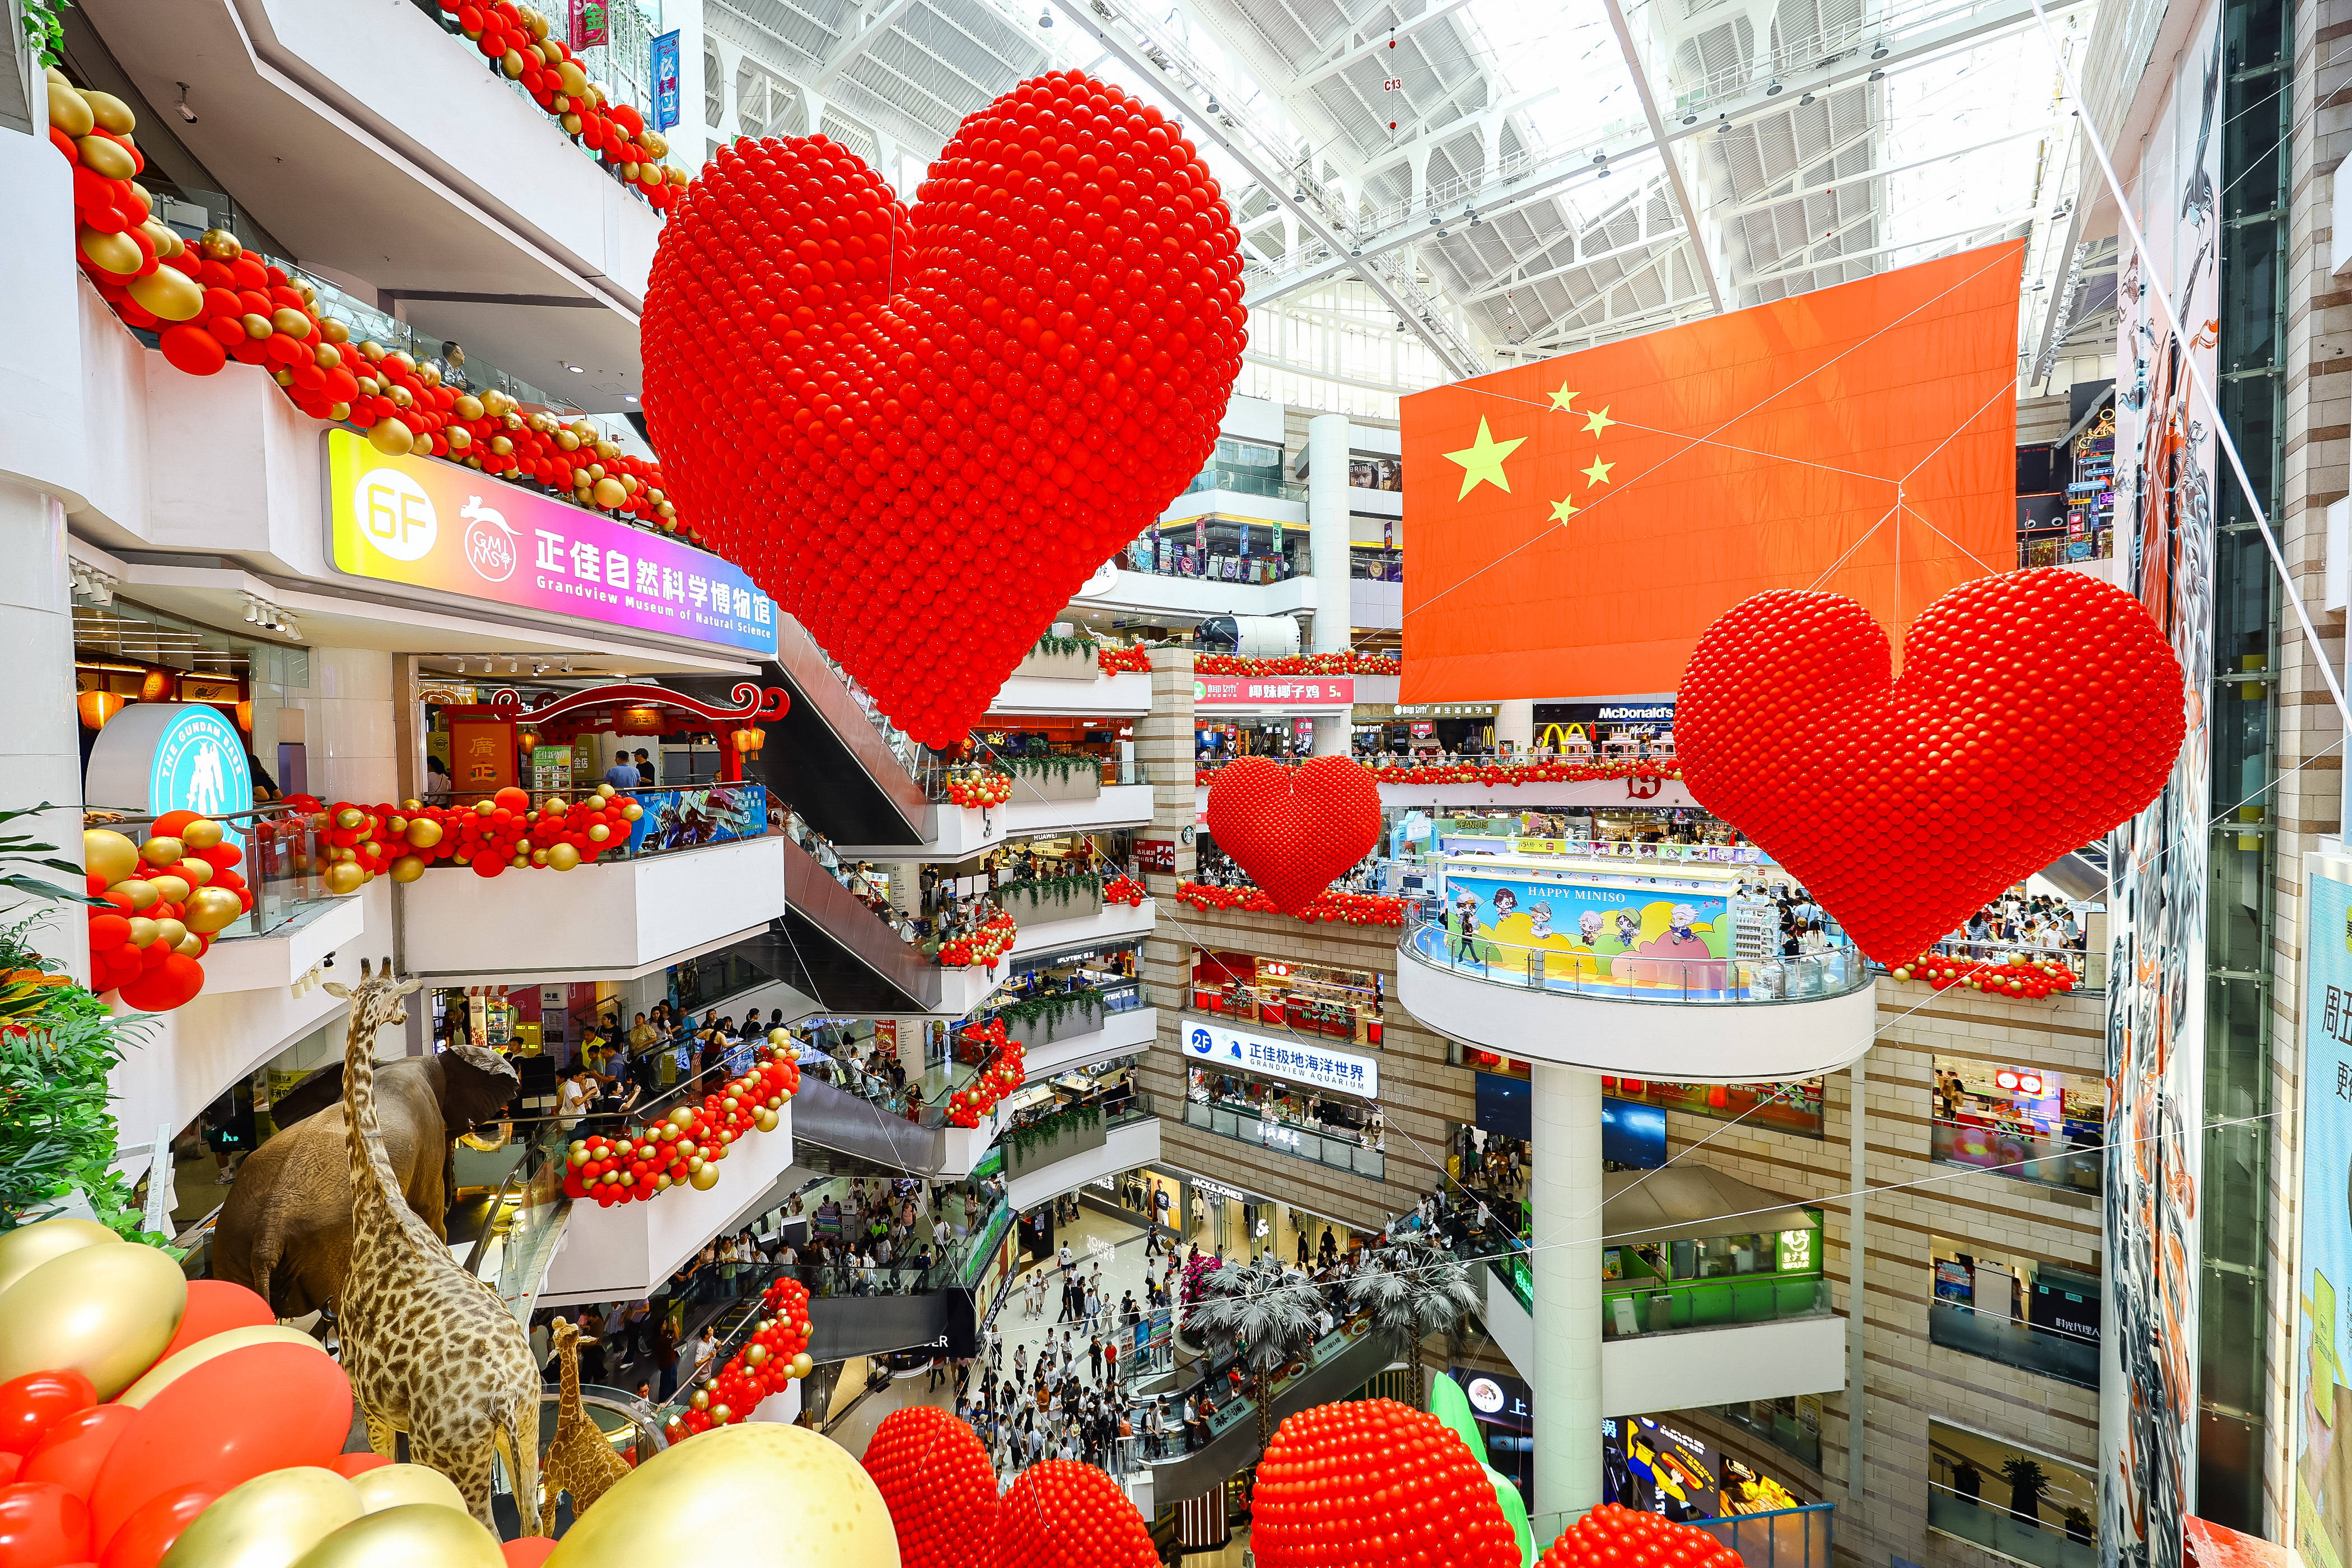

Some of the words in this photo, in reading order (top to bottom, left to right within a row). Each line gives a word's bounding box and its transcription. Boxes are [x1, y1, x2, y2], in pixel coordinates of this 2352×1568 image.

[1384, 79, 1401, 91] C13
[1350, 464, 1372, 473] BRING
[367, 483, 426, 543] 6F
[535, 528, 771, 626] 正佳自然科学博物馆
[536, 575, 618, 604] Grandview
[625, 596, 674, 617] Museum
[679, 609, 691, 621] of
[696, 613, 734, 630] Natural
[738, 622, 771, 639] Science
[1248, 684, 1320, 698] 椰妹椰子鸡
[1598, 707, 1674, 719] McDonald's
[1628, 724, 1656, 736] McCafé
[162, 743, 178, 778] THE
[178, 721, 221, 743] GUNDAM
[223, 736, 242, 776] BASE
[535, 750, 566, 759] 正佳新势力
[1456, 820, 1488, 829] PEANUTS
[1033, 833, 1057, 841] HUAWEI
[1528, 886, 1571, 898] HAPPY
[1574, 889, 1625, 903] MINISO
[1057, 954, 1082, 964] IFLYTEK
[1193, 1033, 1211, 1049] 2F
[1249, 1043, 1364, 1081] 正佳极地海洋世界
[1250, 1058, 1306, 1077] GRANDVIEW
[1310, 1072, 1364, 1090] AQUARIUM
[1190, 1177, 1244, 1201] JACK&JONES
[996, 1272, 1013, 1306] LAUDER
[2056, 1318, 2100, 1337] 时光代理人
